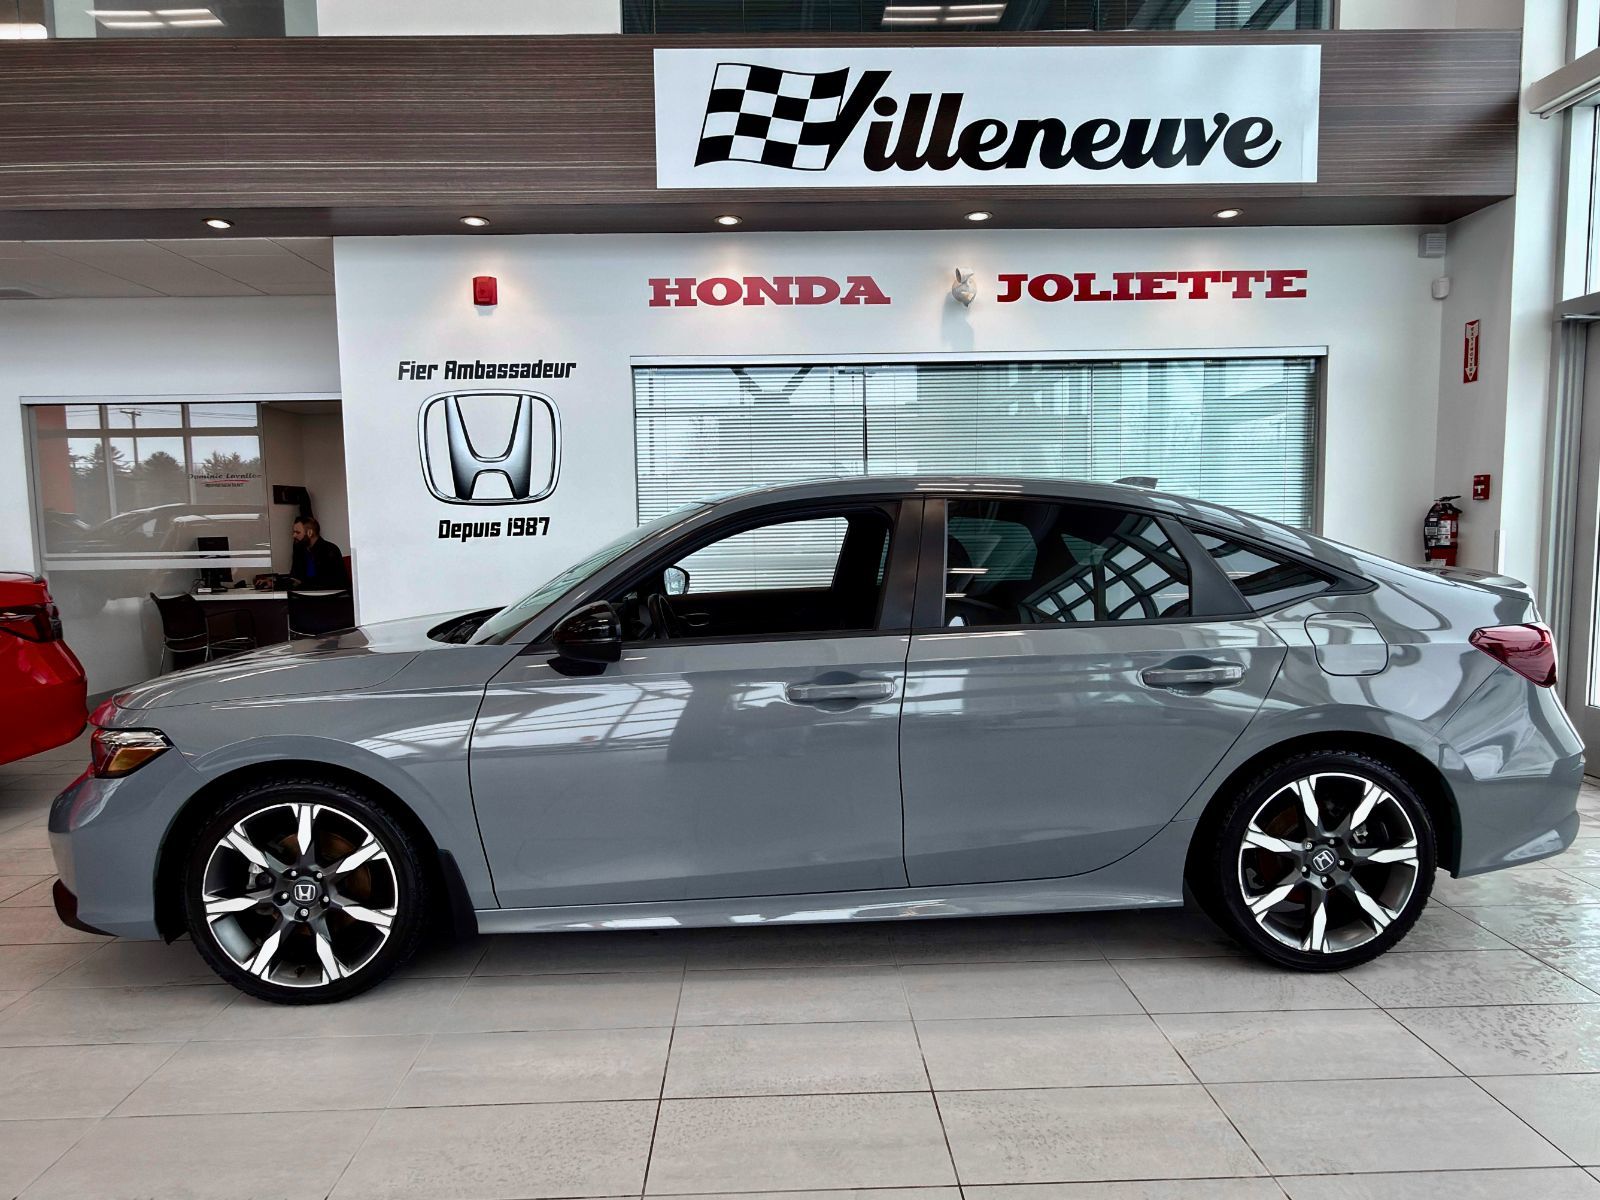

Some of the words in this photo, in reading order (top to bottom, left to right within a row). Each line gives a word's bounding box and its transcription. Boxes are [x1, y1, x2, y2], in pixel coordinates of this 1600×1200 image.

[824, 69, 1282, 172] Villeneuve
[648, 276, 891, 307] HONDA
[997, 269, 1308, 303] JOLIETTE
[398, 361, 439, 380] Fier
[444, 360, 577, 380] Ambassadeur
[438, 519, 501, 542] Depuis
[506, 516, 550, 537] 1987
